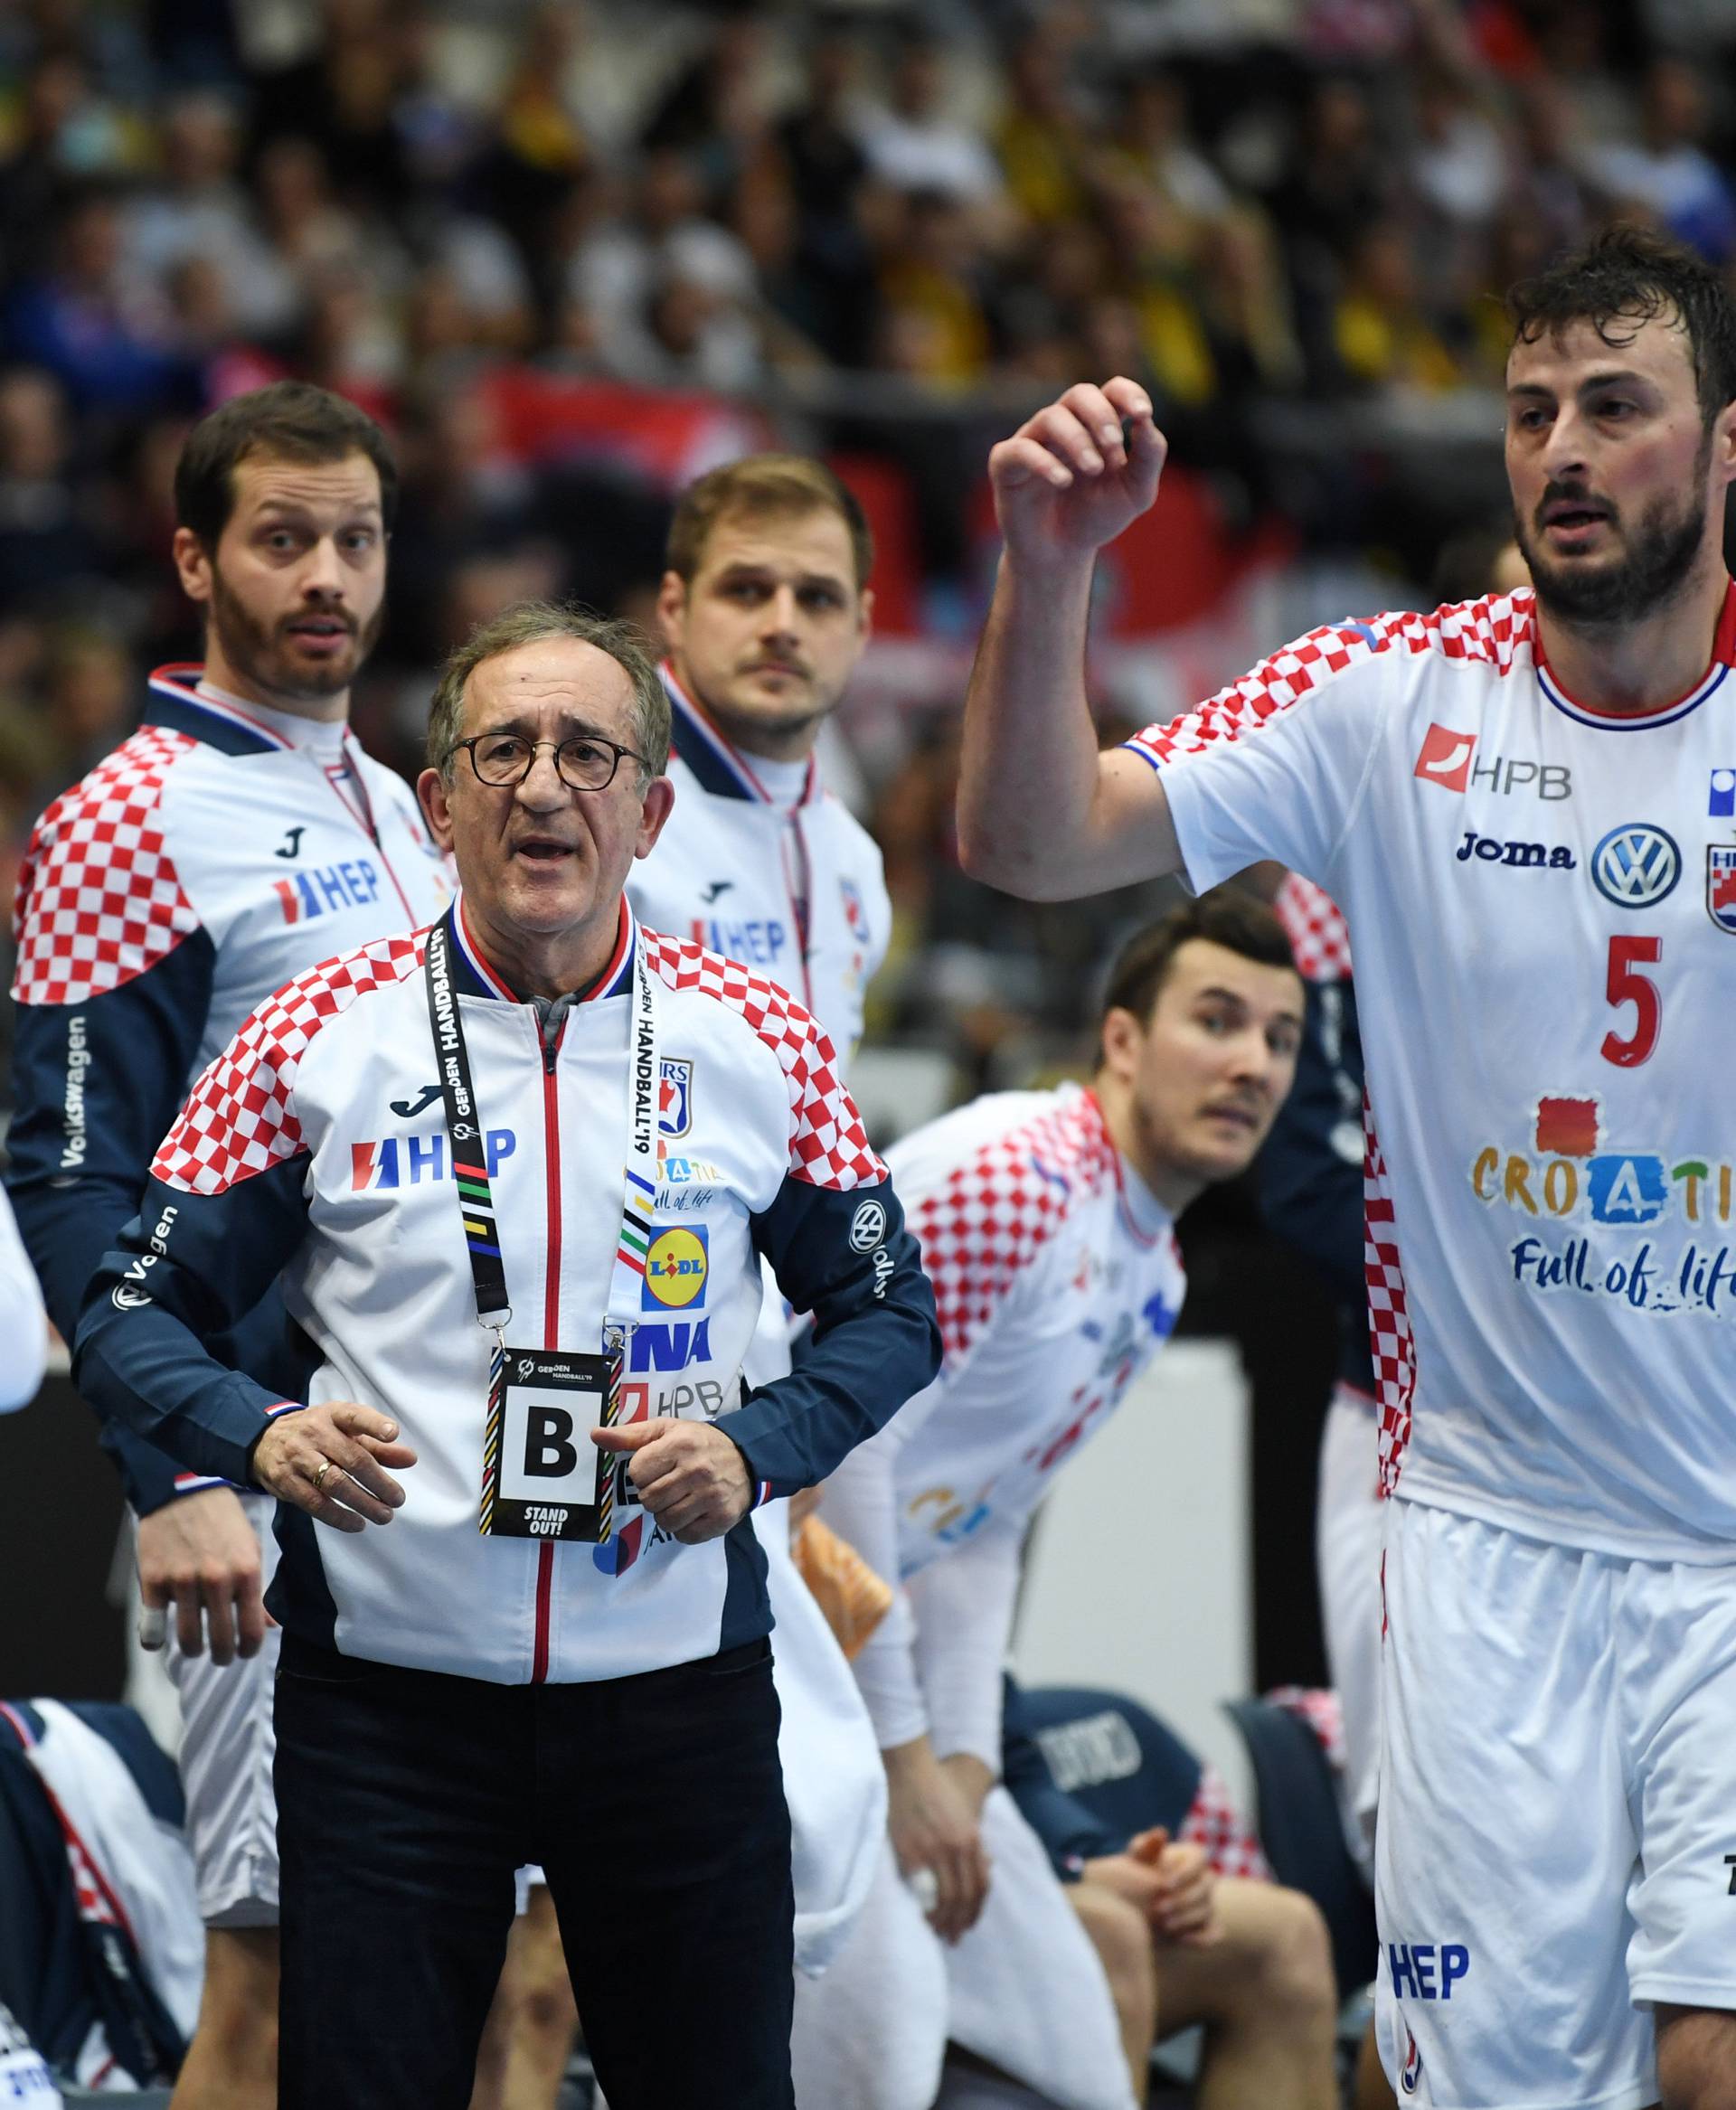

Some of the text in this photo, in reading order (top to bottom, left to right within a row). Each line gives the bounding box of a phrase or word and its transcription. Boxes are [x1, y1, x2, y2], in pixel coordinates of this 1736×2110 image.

[1472, 755, 1572, 801] HPB
[1457, 832, 1577, 870] Joma
[315, 859, 380, 911] HEP
[727, 918, 786, 964] HEP
[1599, 935, 1664, 1069] 5
[60, 1016, 92, 1168] Volkswagen
[634, 1018, 655, 1155] HANDBALL'19
[658, 1061, 688, 1082] RS
[408, 1129, 517, 1185] HP
[1606, 1244, 1658, 1307] of
[524, 1406, 578, 1478] B
[524, 1506, 569, 1522] STAND
[529, 1521, 563, 1536] OUT!
[1389, 1944, 1469, 2000] HEP
